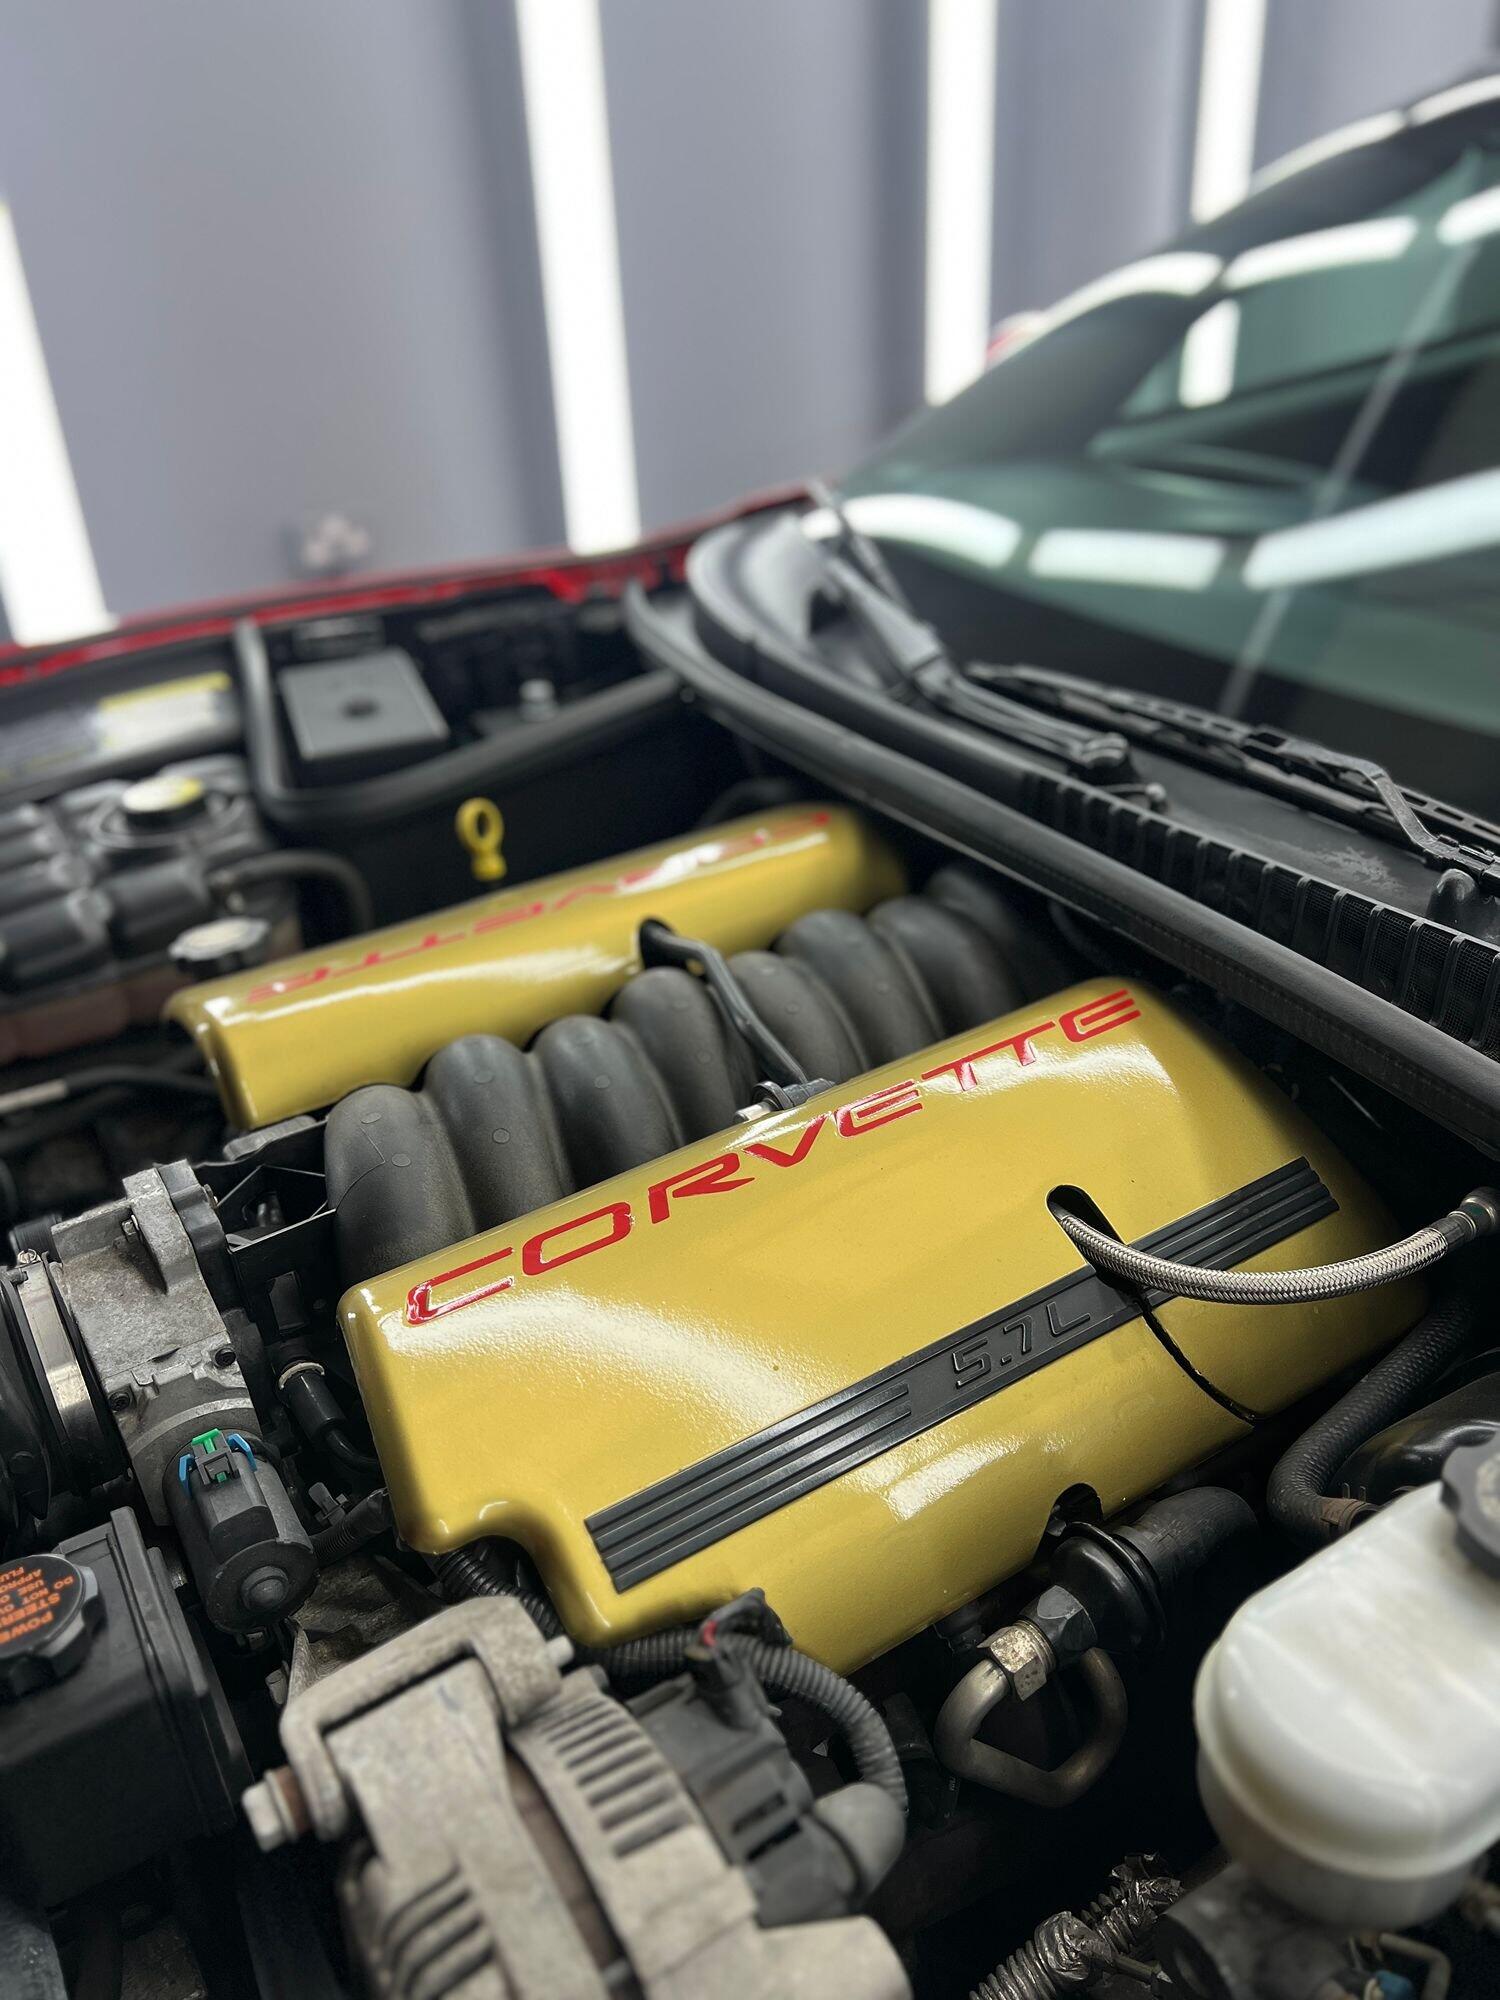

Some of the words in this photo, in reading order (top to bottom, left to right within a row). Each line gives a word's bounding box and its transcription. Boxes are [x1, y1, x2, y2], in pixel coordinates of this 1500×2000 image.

[405, 989, 1141, 1325] CORVETTE
[952, 1301, 1091, 1389] 5.7L
[18, 1578, 45, 1596] USE
[22, 1587, 49, 1605] NOT
[54, 1576, 73, 1590] DO
[0, 1593, 60, 1627] STEER
